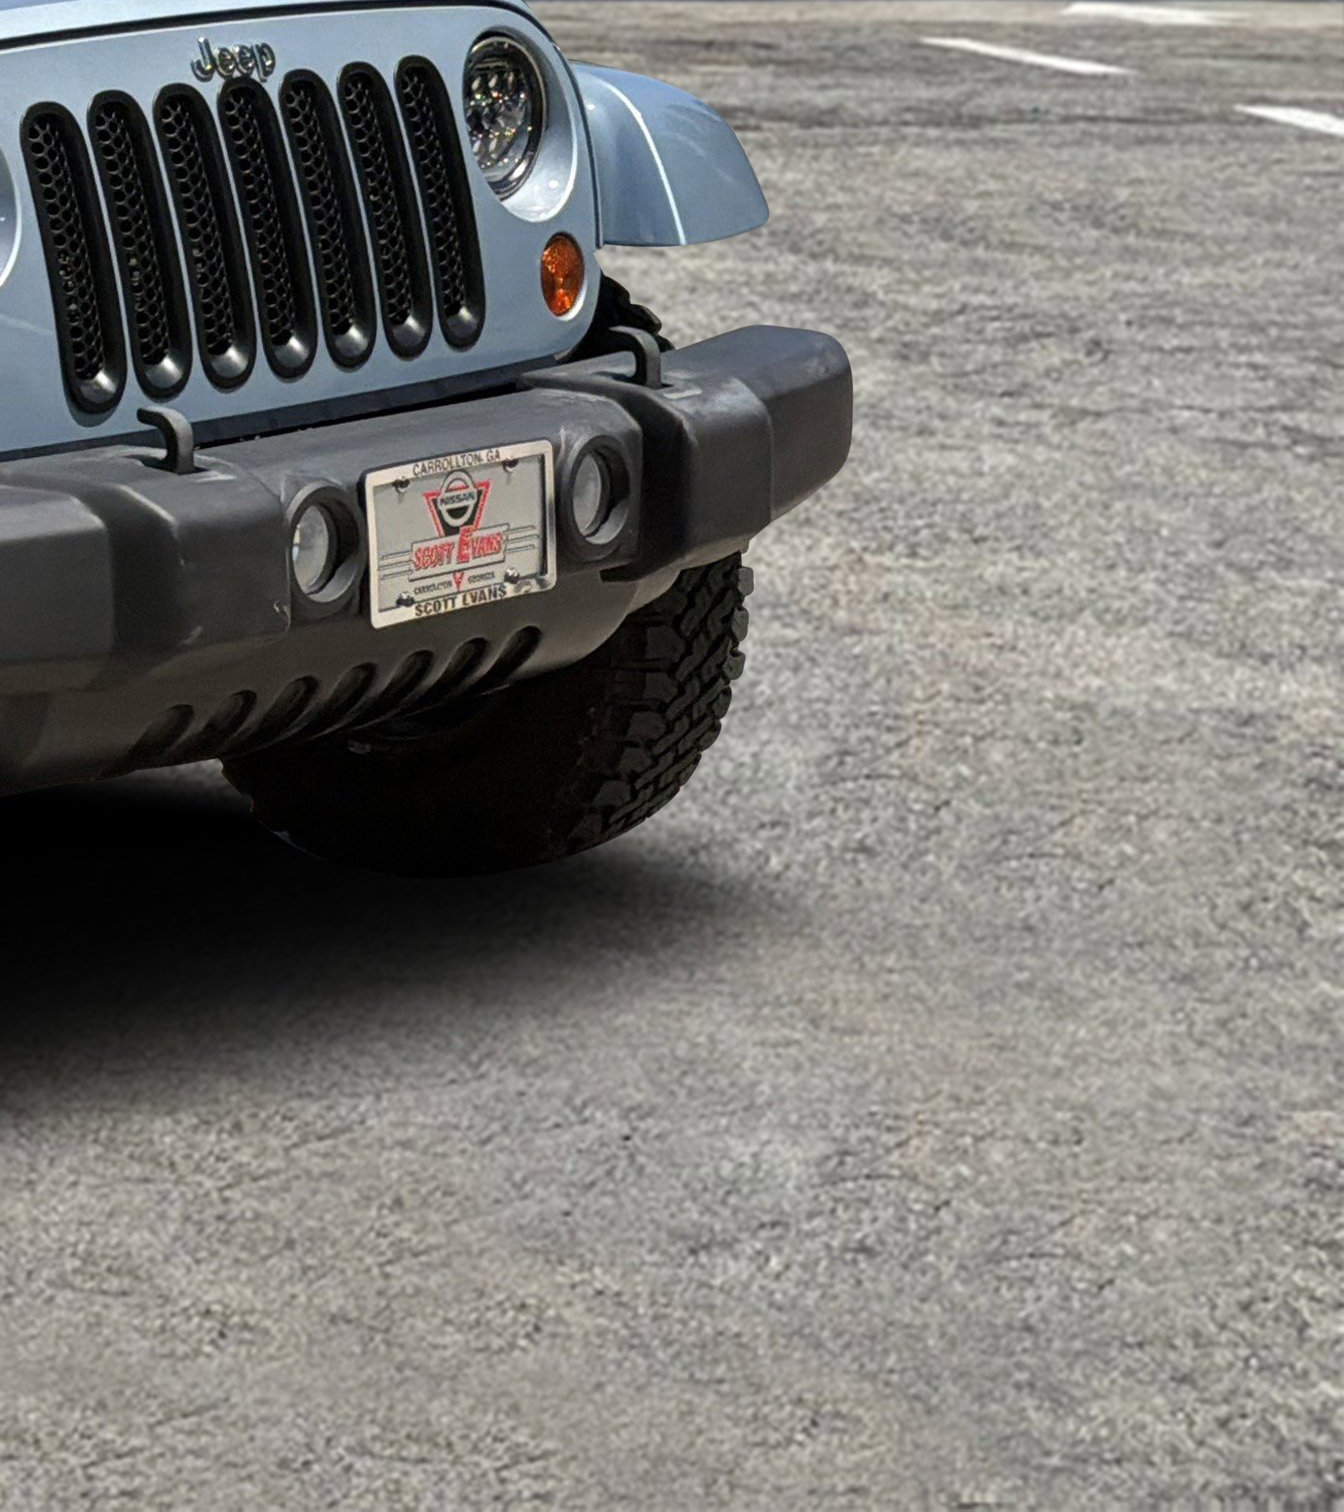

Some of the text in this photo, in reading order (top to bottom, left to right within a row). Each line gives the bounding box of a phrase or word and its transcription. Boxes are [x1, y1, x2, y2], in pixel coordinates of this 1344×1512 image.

[191, 36, 276, 83] Jeep
[486, 449, 501, 463] GA
[440, 491, 476, 506] NISSAN
[414, 525, 503, 572] SCOTT EVANS
[414, 596, 458, 617] SCOTT
